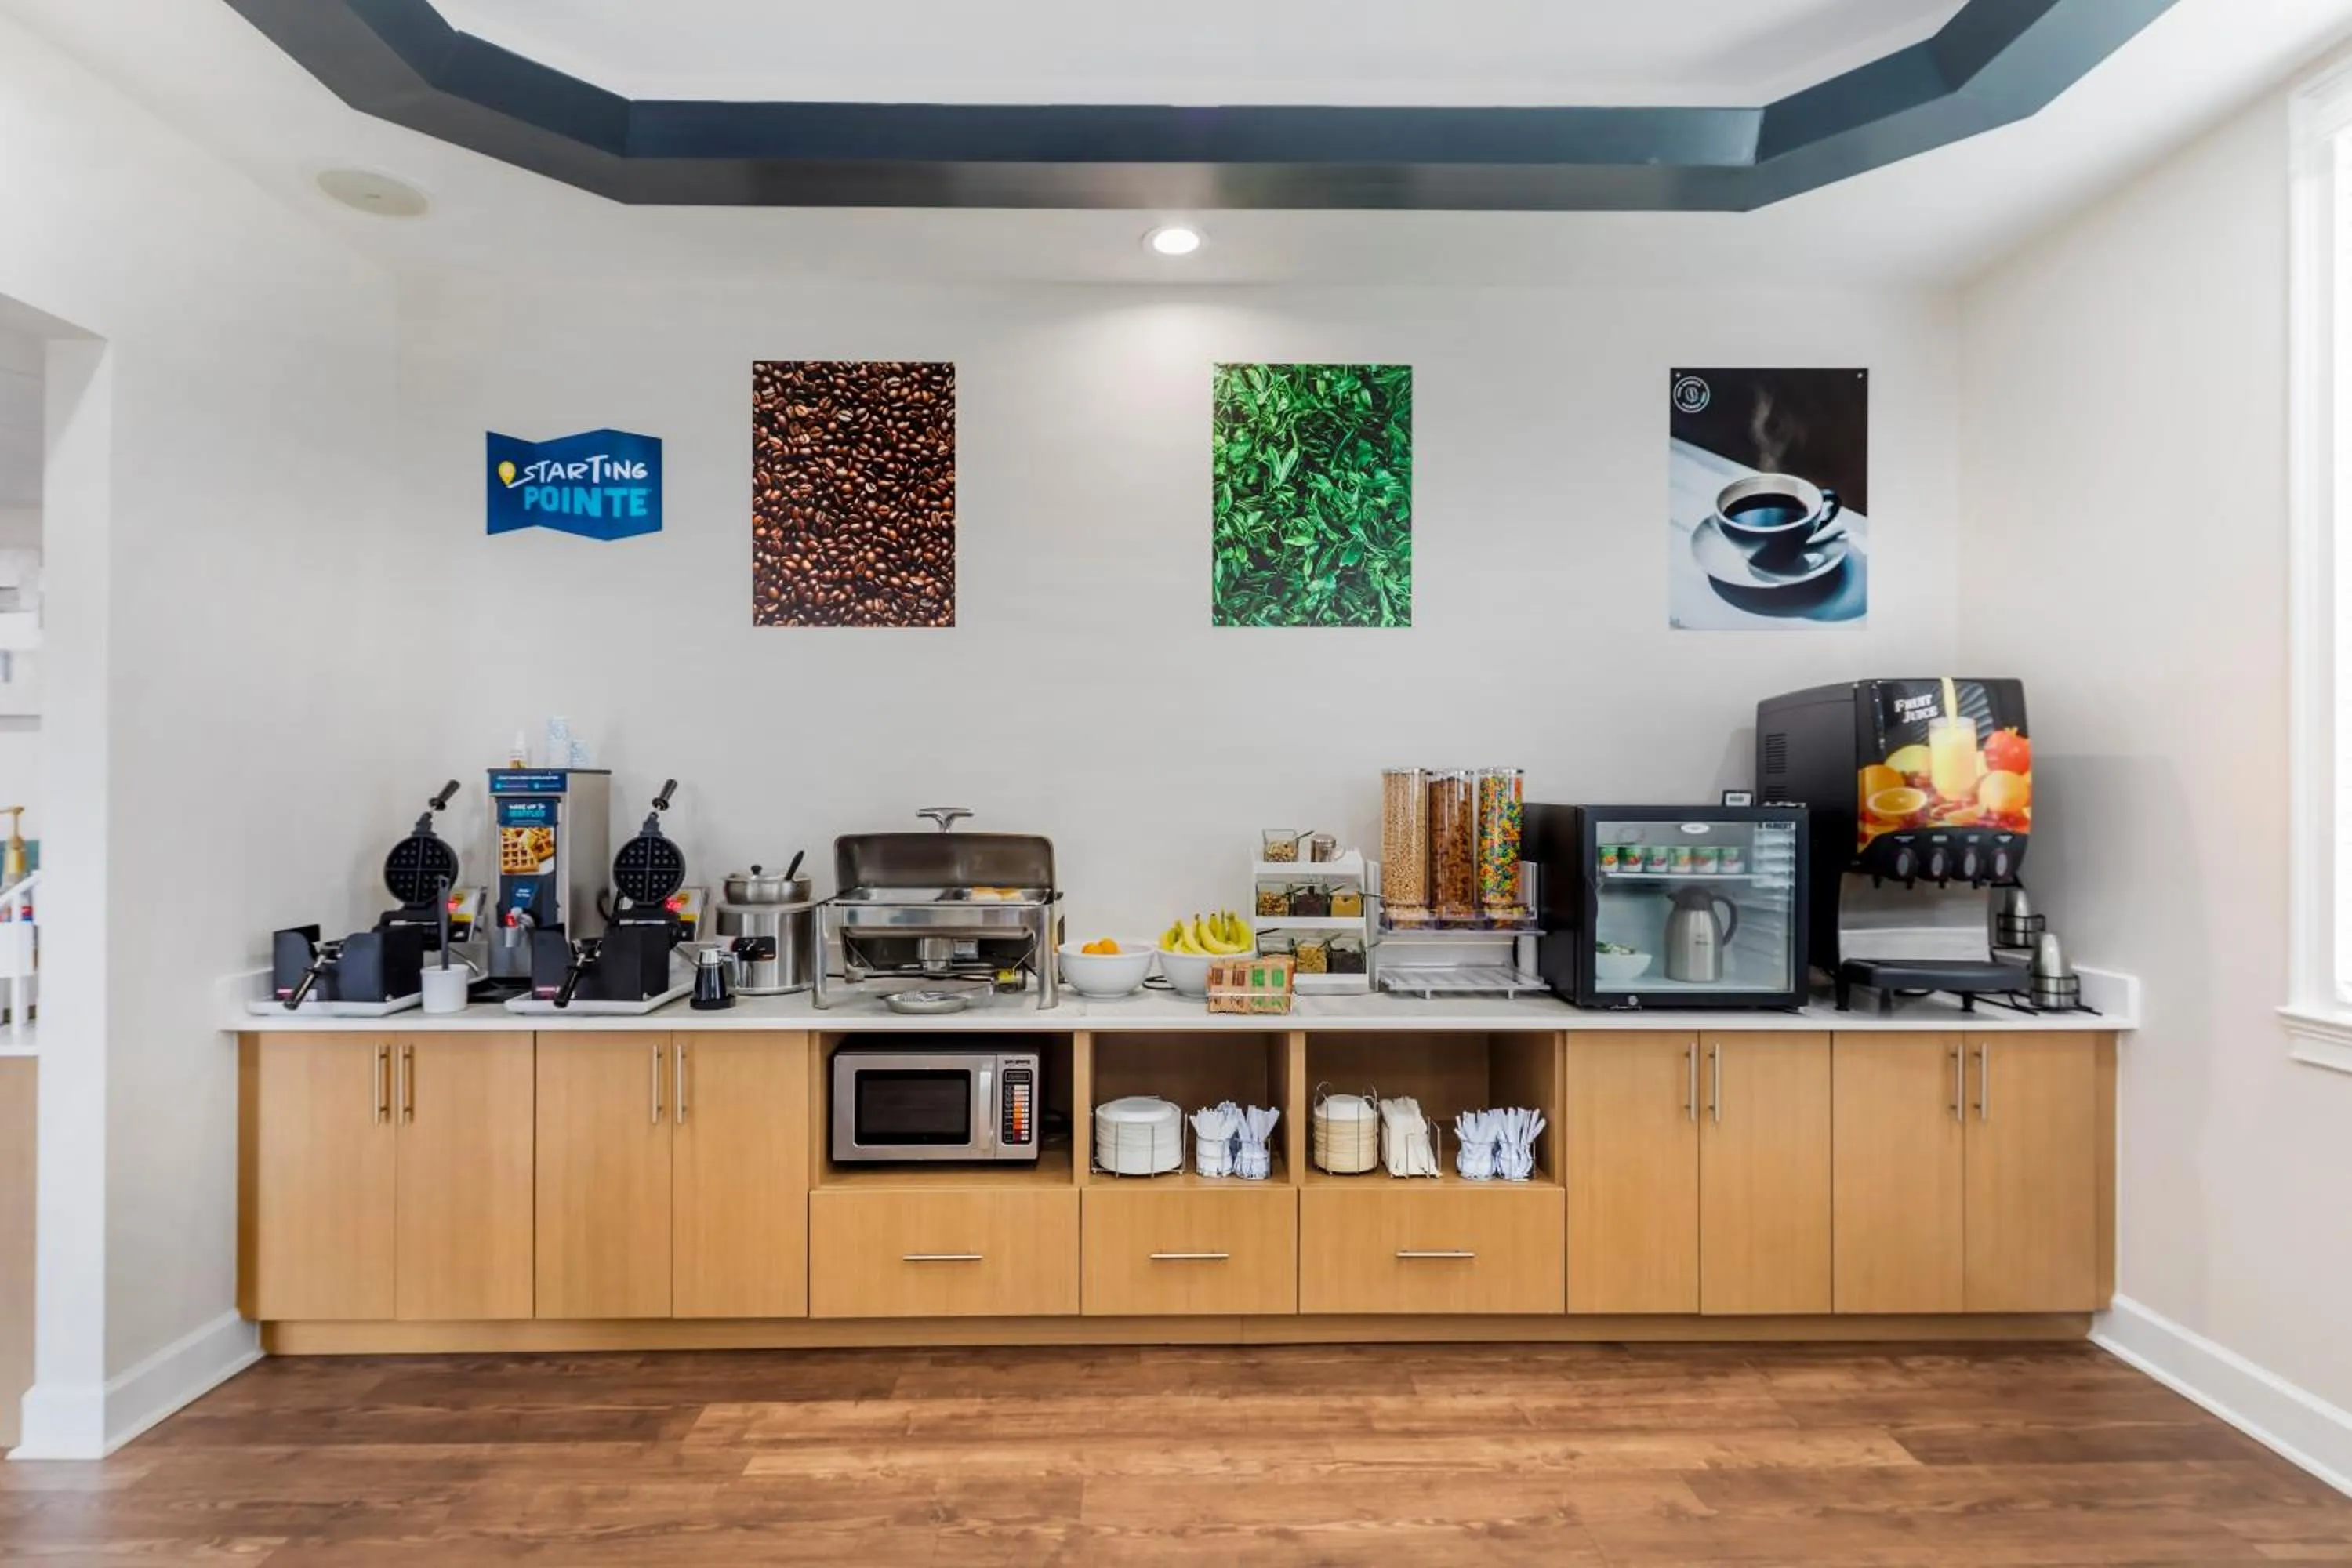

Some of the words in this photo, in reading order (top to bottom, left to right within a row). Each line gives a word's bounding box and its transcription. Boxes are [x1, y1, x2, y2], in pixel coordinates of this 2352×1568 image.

[508, 453, 649, 488] STARTING
[524, 485, 649, 518] POINTE
[1894, 694, 1933, 713] FRUIT
[1902, 705, 1939, 723] JUICE
